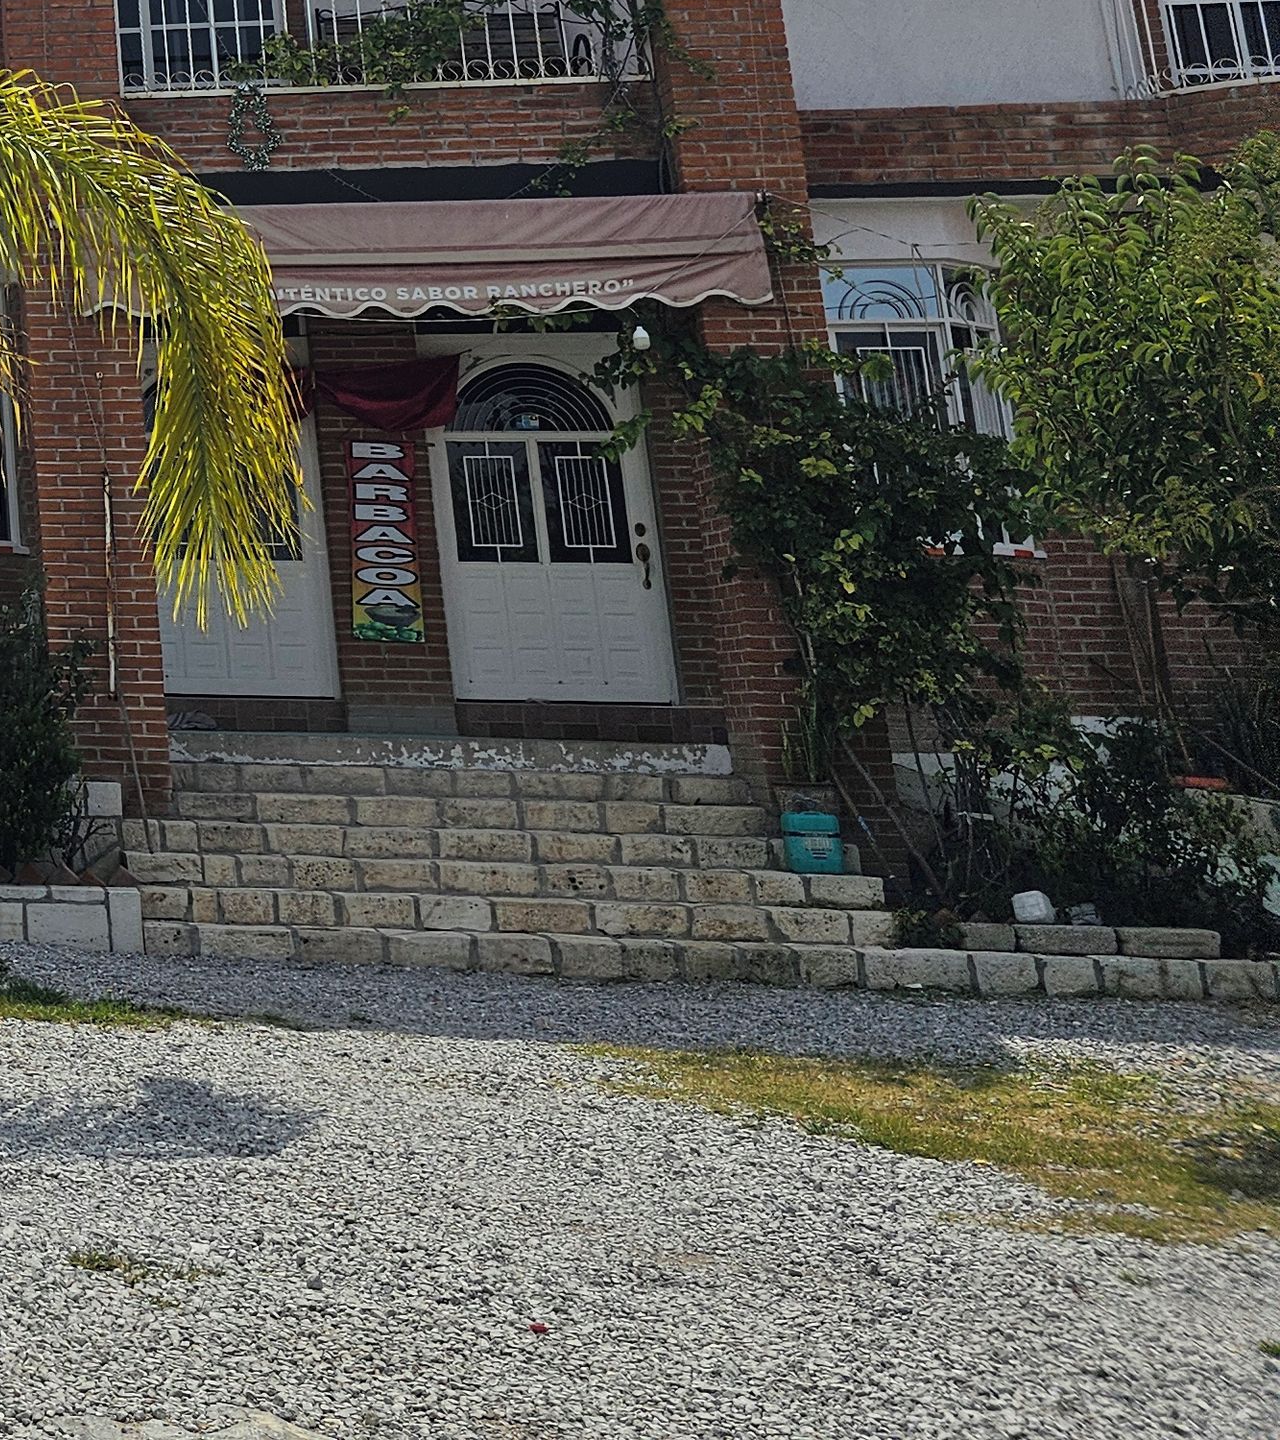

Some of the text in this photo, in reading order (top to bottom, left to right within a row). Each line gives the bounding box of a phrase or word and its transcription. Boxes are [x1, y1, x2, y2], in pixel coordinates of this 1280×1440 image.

[269, 283, 388, 302] UTÉNTICO
[396, 285, 479, 301] SABOR
[351, 441, 421, 608] BARBACOA
